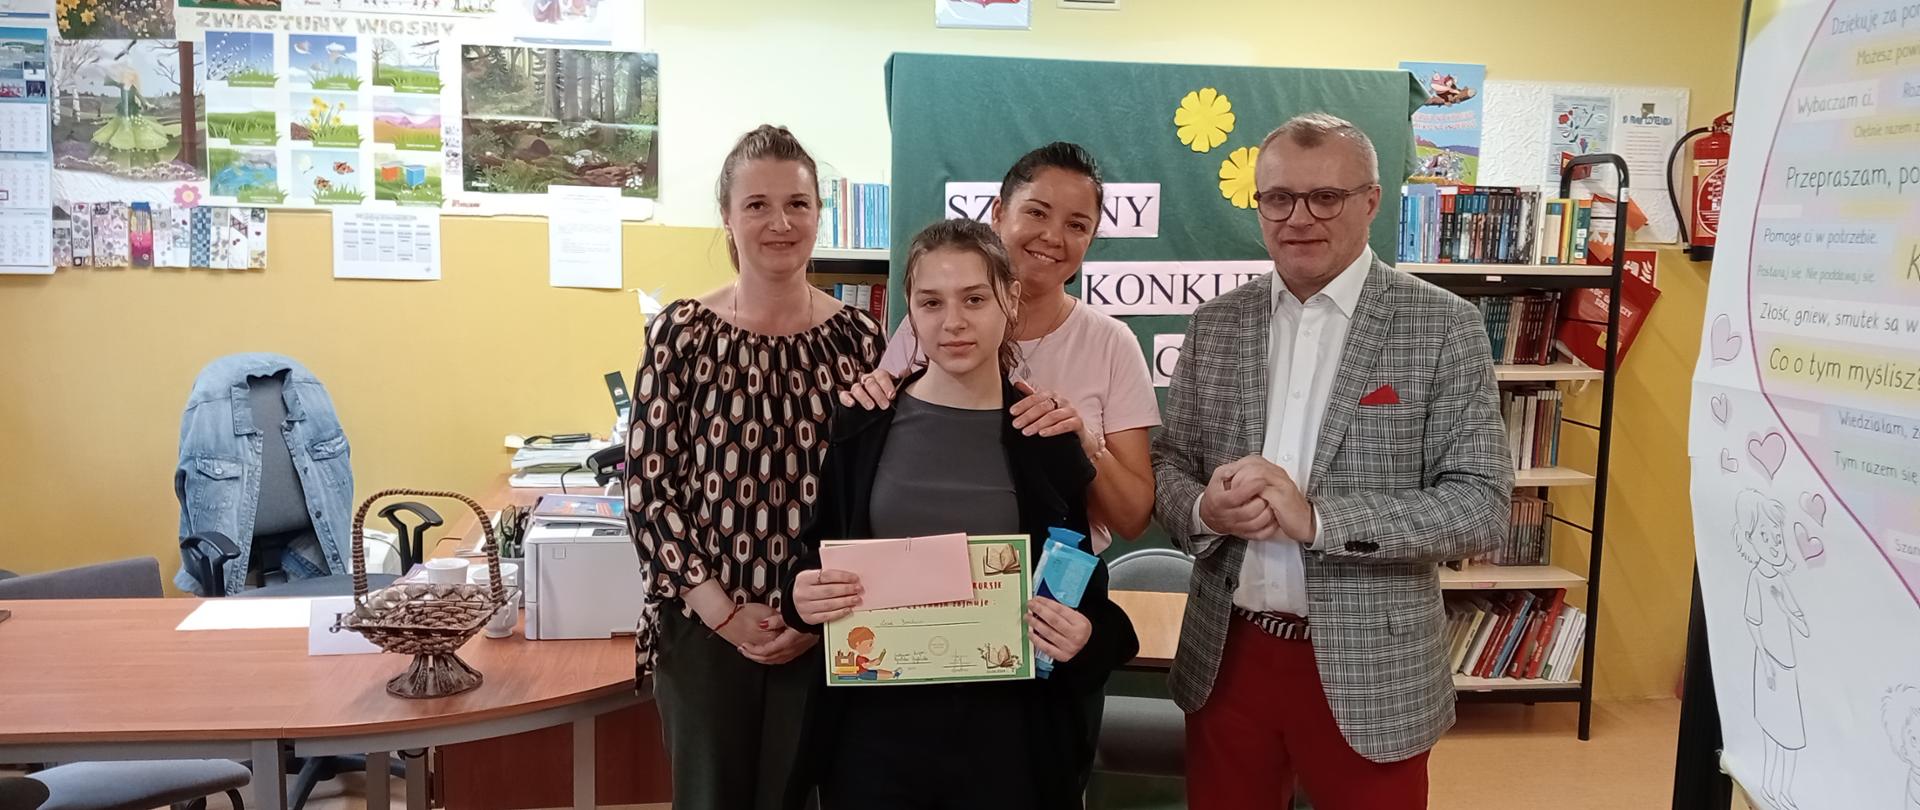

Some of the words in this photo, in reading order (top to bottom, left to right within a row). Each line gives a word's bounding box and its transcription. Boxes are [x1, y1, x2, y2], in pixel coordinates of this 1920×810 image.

[195, 11, 348, 33] ZWIASTUNY
[356, 18, 455, 36] WIOSNY
[1882, 9, 1897, 25] za
[1798, 95, 1858, 117] Wybaczam
[1785, 166, 1892, 196] Przepraszam,
[948, 194, 1154, 229] SZNY
[1763, 227, 1801, 246] Pomogę
[1815, 232, 1825, 243] w
[1084, 272, 1262, 305] KONKU
[1760, 302, 1791, 323] Złość,
[1794, 307, 1830, 327] gniew,
[1835, 310, 1879, 329] smutek
[1884, 319, 1899, 335] są
[1769, 348, 1789, 371] Co
[1793, 356, 1804, 374] o
[1809, 353, 1841, 383] tym
[1832, 449, 1858, 471] Tym
[1861, 460, 1898, 478] razem
